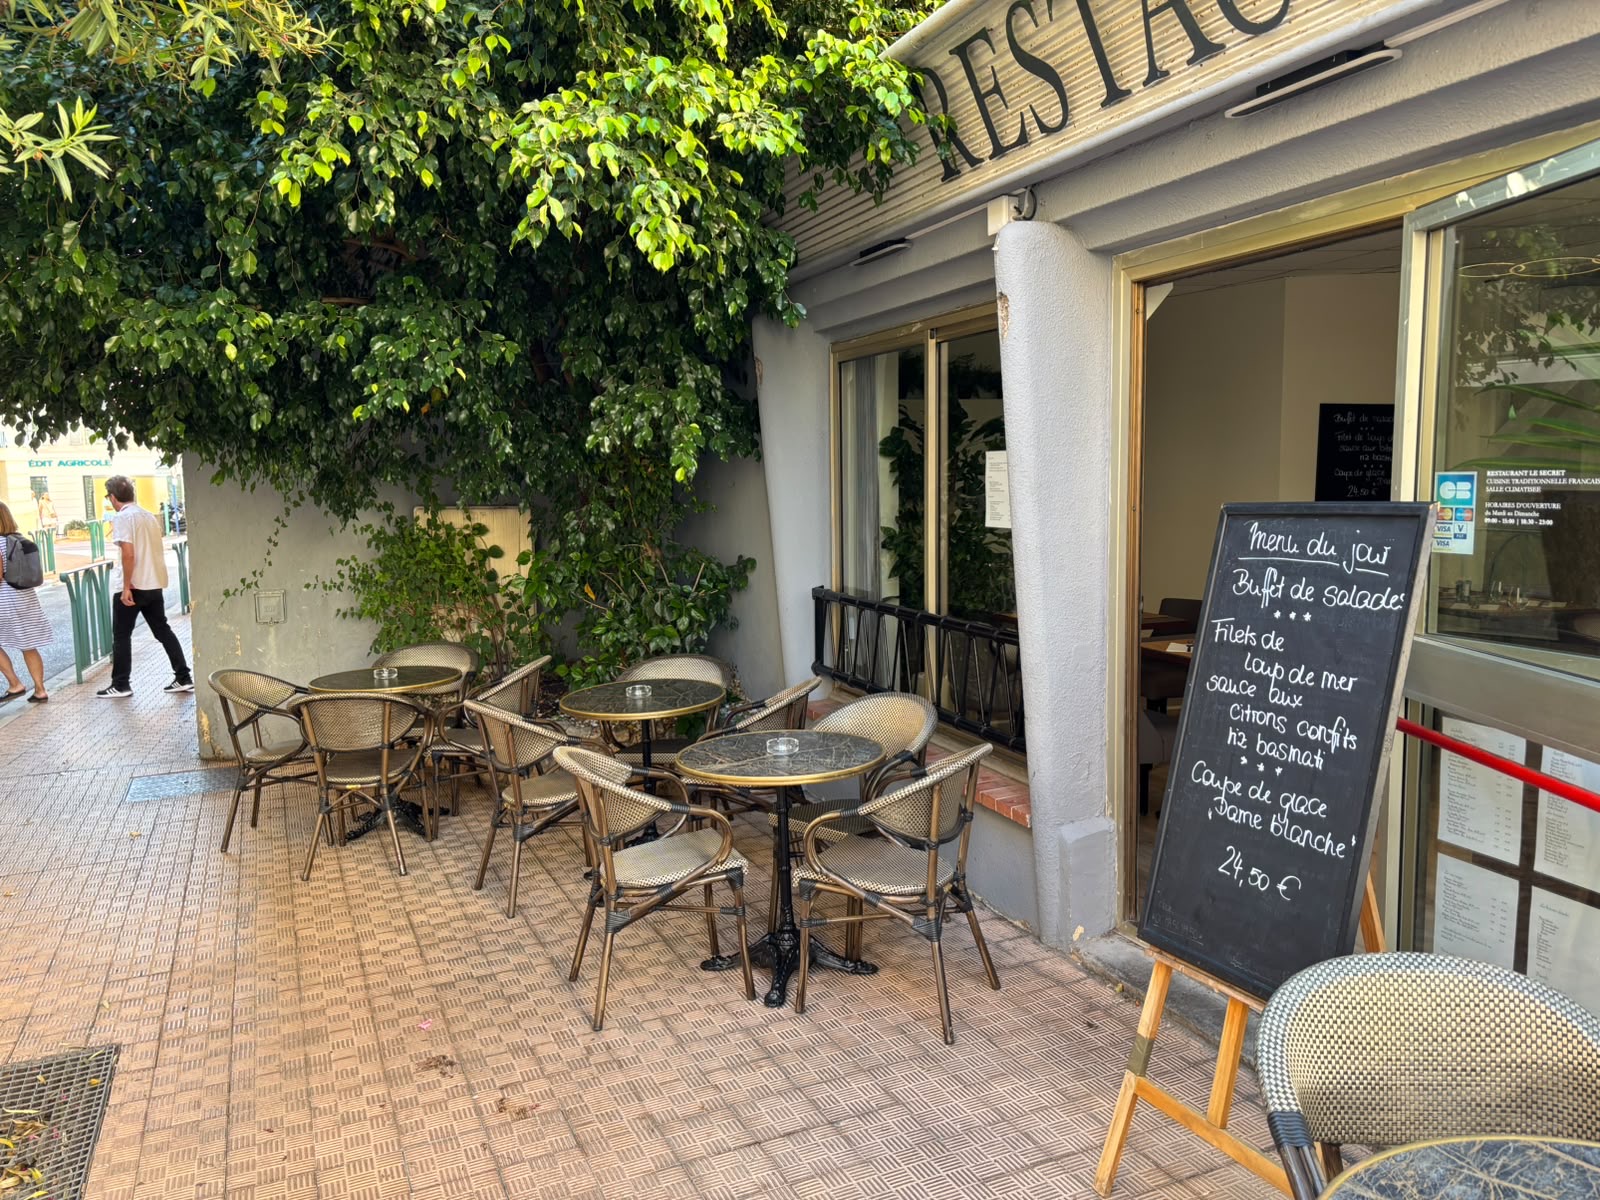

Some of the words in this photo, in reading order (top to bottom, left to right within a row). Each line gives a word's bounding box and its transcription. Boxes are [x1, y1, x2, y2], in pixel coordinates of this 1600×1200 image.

[57, 459, 112, 467] AGRICOLE
[1486, 469, 1528, 477] RESTAURANT
[1516, 502, 1561, 510] D'OUVERTURE
[1307, 532, 1337, 556] du
[1342, 529, 1391, 574] jour
[1232, 566, 1285, 609] Buffet
[1290, 577, 1315, 601] de
[1211, 617, 1257, 646] Filets
[1261, 630, 1285, 651] de
[1206, 675, 1257, 697] sauce
[1288, 664, 1315, 686] de
[1227, 727, 1247, 749] riz
[1256, 733, 1327, 770] basmati
[1191, 760, 1243, 804] Coupe
[1248, 780, 1272, 804] de
[1279, 792, 1328, 824] glace
[1217, 845, 1270, 891] 24,50
[1276, 875, 1302, 901] €
